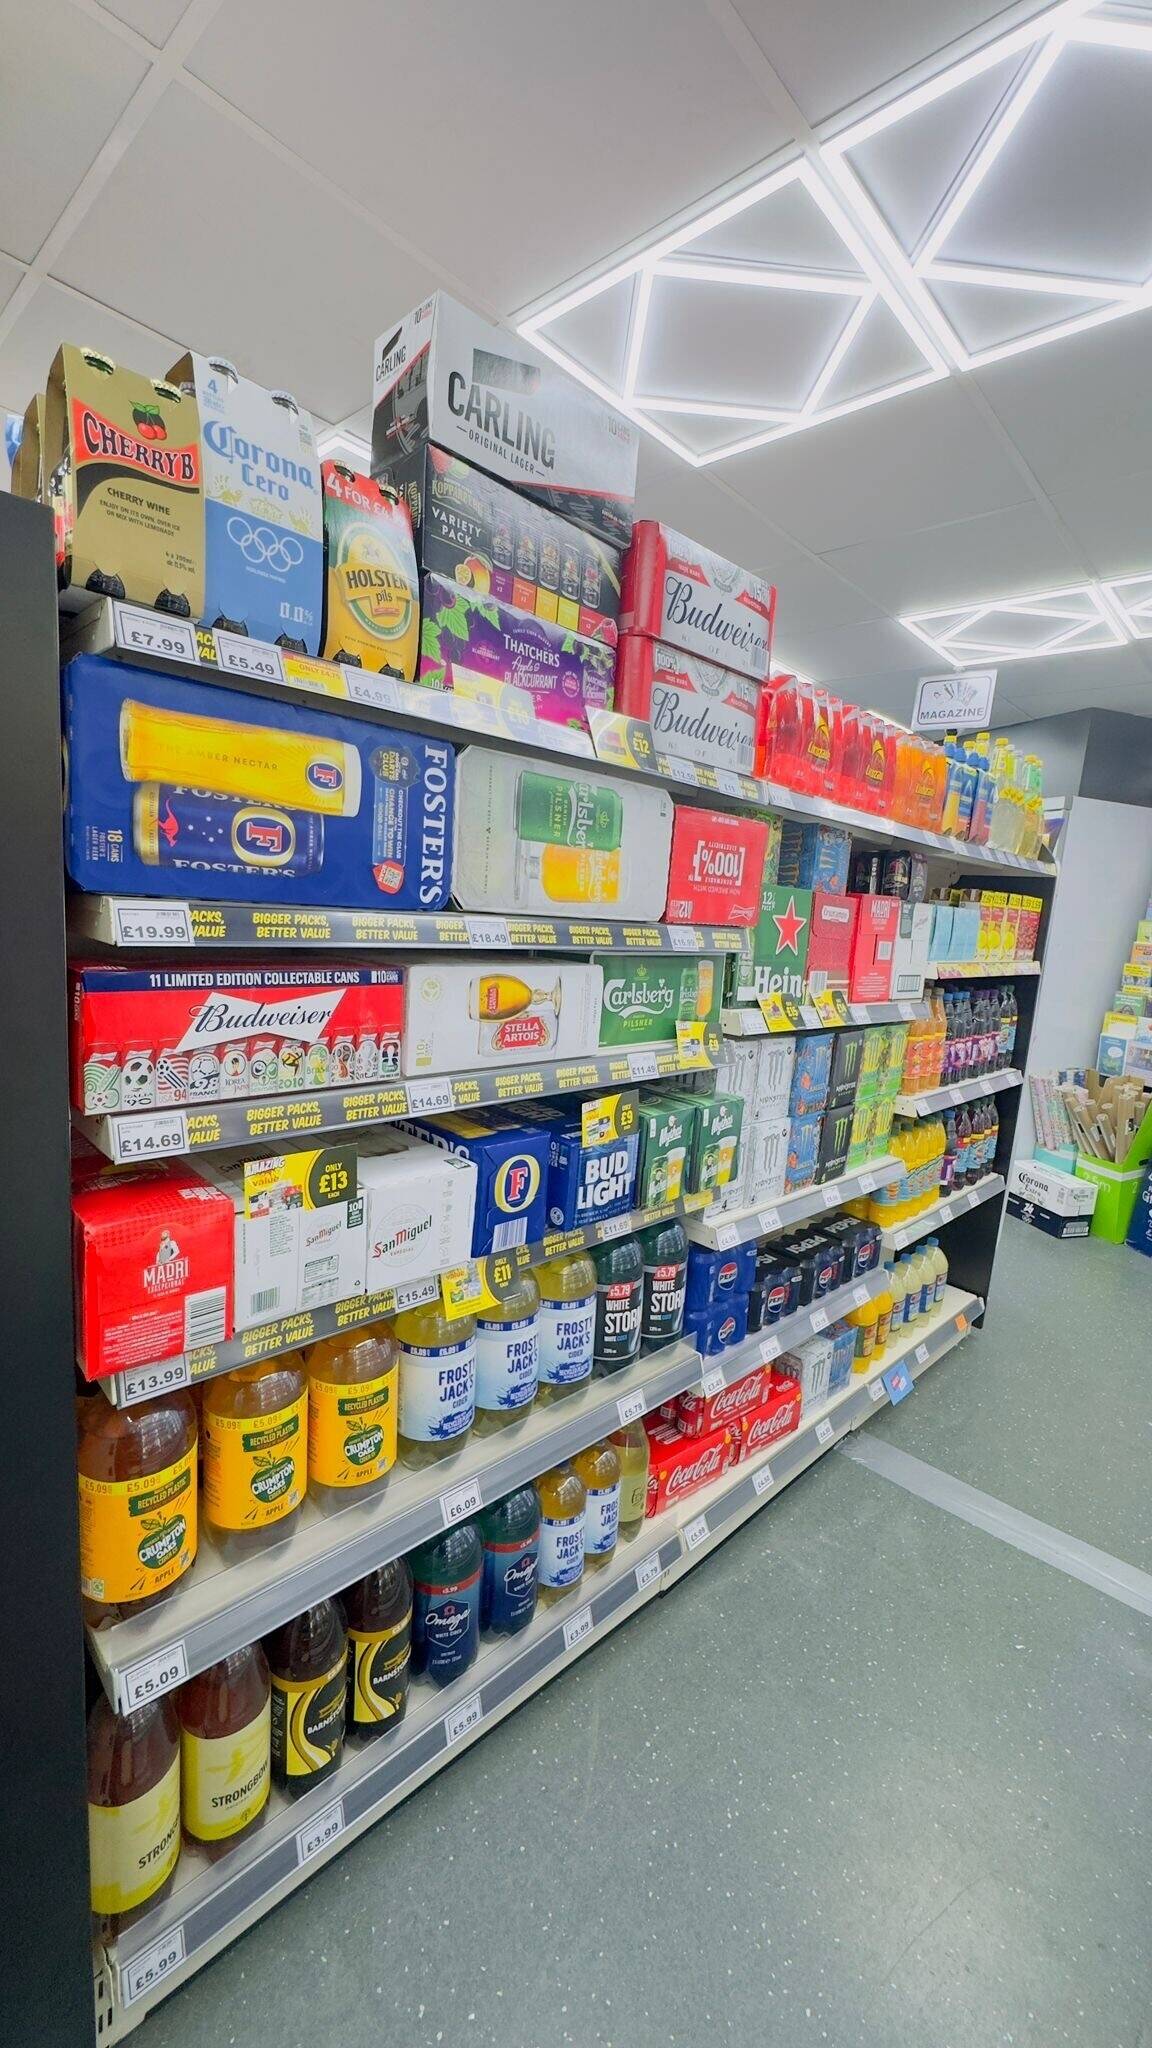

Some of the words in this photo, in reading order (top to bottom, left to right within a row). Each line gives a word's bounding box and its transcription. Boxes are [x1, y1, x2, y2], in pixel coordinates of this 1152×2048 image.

[376, 346, 406, 382] CARLING
[208, 379, 218, 393] 4
[447, 371, 556, 469] CARLING
[203, 420, 314, 491] Corona
[468, 428, 508, 460] ORIGINAL
[510, 453, 535, 475] LAGER
[241, 464, 290, 501] Cero
[108, 487, 144, 507] CHERRY
[146, 501, 171, 516] WINE
[326, 474, 343, 498] 4
[344, 488, 371, 511] FOR
[128, 518, 143, 527] WITH
[432, 507, 482, 538] VARIETY
[441, 525, 473, 548] PACK
[346, 570, 409, 592] HOLSTEN
[376, 588, 394, 606] pils
[280, 602, 313, 626] 0.0%
[130, 631, 185, 654] £7.99
[504, 633, 560, 668] THATCHERS
[228, 654, 275, 676] £5.49
[512, 656, 533, 678] Apple
[504, 672, 558, 690] BLACKCURRANT
[920, 706, 985, 721] MAGAZINE
[633, 738, 650, 755] £12
[188, 748, 229, 762] AMBER
[234, 757, 278, 770] NECTAR
[388, 788, 396, 824] CHANCE
[553, 786, 563, 838] PILSNER
[387, 827, 394, 839] TO
[419, 744, 448, 904] FOSTER'S
[107, 829, 122, 845] 18
[246, 821, 283, 853] F
[110, 843, 120, 863] CANS
[386, 841, 394, 859] WIN
[702, 850, 740, 878] 100%
[762, 892, 773, 904] 12
[870, 900, 890, 919] MADRI
[252, 912, 292, 926] BIGGER
[294, 914, 329, 927] PACKS,
[122, 926, 186, 940] £19.99
[256, 926, 298, 938] BETTER
[300, 927, 332, 939] VALUE
[472, 932, 508, 945] £18.49
[150, 974, 160, 988] 11
[164, 973, 214, 988] LIMITED
[216, 972, 262, 986] EDITION
[264, 972, 332, 985] COLLECTABLE
[334, 971, 360, 984] CANS
[754, 966, 803, 998] Hein
[603, 976, 674, 1011] Carlsberg
[188, 1003, 332, 1033] Budweiser
[504, 1020, 540, 1033] STELLA
[623, 1017, 653, 1028] PILSNER
[504, 1030, 540, 1042] ARTOIS
[632, 1064, 656, 1074] £11.49
[278, 1077, 304, 1088] 2010
[174, 1088, 188, 1101] 94
[413, 1094, 449, 1110] £14.69
[246, 1106, 286, 1120] BIGGER
[287, 1101, 321, 1115] PACKS,
[621, 1110, 634, 1125] £9
[250, 1120, 290, 1136] BETTER
[292, 1114, 322, 1128] VALUE
[122, 1133, 182, 1152] £14.69
[326, 1162, 342, 1172] ONLY
[586, 1150, 630, 1180] BUD
[252, 1174, 280, 1187] value
[318, 1170, 348, 1194] £13
[509, 1168, 528, 1201] F
[1018, 1172, 1049, 1192] Corona
[577, 1173, 632, 1208] LIGHT
[604, 1221, 628, 1235] £11.69
[825, 1218, 860, 1234] PEPSI
[786, 1235, 828, 1254] PEPSI
[144, 1257, 190, 1288] MADRI
[494, 1266, 512, 1282] £11
[656, 1266, 676, 1278] £5.79
[608, 1286, 632, 1298] £5.79
[652, 1279, 676, 1292] WHITE
[397, 1286, 434, 1305] £15.49
[606, 1298, 630, 1311] WHITE
[556, 1318, 592, 1337] FROSTY
[556, 1332, 590, 1351] JACK'S
[568, 1350, 584, 1359] CIDER
[126, 1368, 184, 1394] £13.99
[519, 1370, 534, 1381] CIDER
[440, 1377, 474, 1402] JACK'S
[344, 1398, 366, 1412] RECYCLED
[452, 1397, 468, 1410] CIDER
[624, 1404, 643, 1419] £5.79
[250, 1431, 274, 1448] RECYCLED
[344, 1431, 384, 1458] CRUMPTON
[357, 1446, 376, 1458] OAKS
[252, 1460, 295, 1496] CRUMPTON
[356, 1468, 373, 1478] APPLE
[266, 1479, 286, 1495] OAKS
[137, 1492, 164, 1510] RECYCLED
[266, 1503, 284, 1518] APPLE
[450, 1496, 476, 1518] £6.09
[138, 1520, 186, 1563] CRUMPTON
[156, 1542, 178, 1560] OAKS
[154, 1568, 176, 1584] APPLE
[640, 1564, 658, 1583] £3.79
[425, 1608, 471, 1630] Omega
[434, 1630, 449, 1639] WHITE
[570, 1620, 590, 1642] £3.99
[134, 1666, 179, 1700] £5.09
[452, 1711, 479, 1736] £5.99
[138, 1814, 180, 1870] STRONG
[306, 1822, 338, 1854] £3.99
[135, 1951, 177, 1990] £5.99
